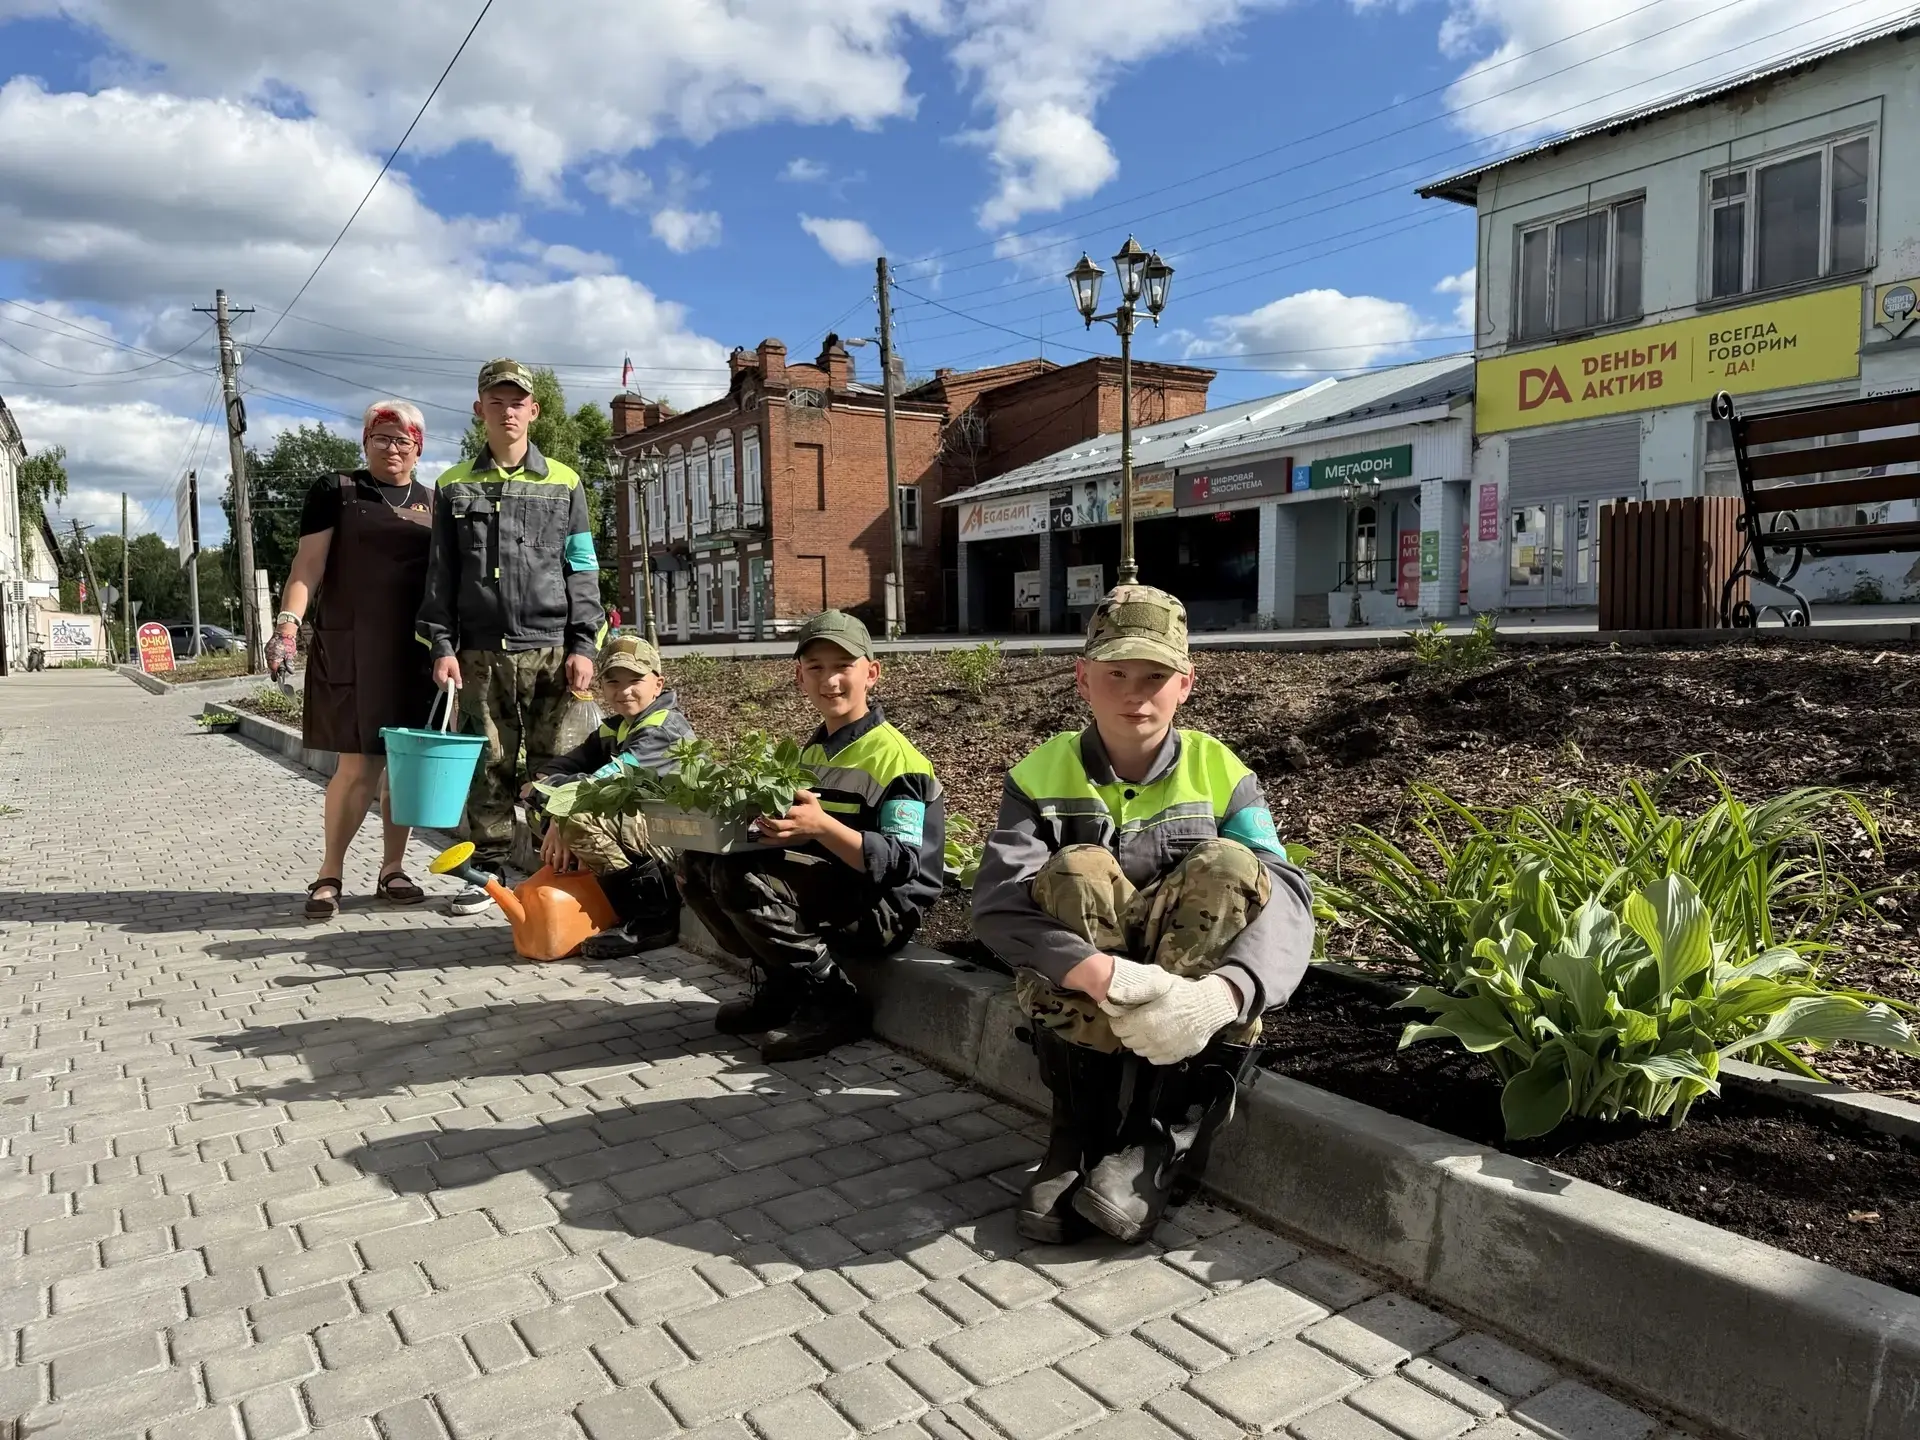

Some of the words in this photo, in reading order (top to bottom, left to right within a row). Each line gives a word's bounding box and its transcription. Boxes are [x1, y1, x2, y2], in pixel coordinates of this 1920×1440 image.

[1709, 321, 1778, 346] ВСЕГДА
[1708, 334, 1797, 362] ГОВОРИМ
[1724, 358, 1755, 377] ДА!
[1581, 369, 1663, 401] АКТИВ
[1325, 457, 1393, 479] МЕГАФОН
[1211, 471, 1254, 486] ЦИФРОВАЯ
[1211, 479, 1263, 494] ЭКОСИСТЕМА
[140, 635, 169, 648] ОЧКИ
